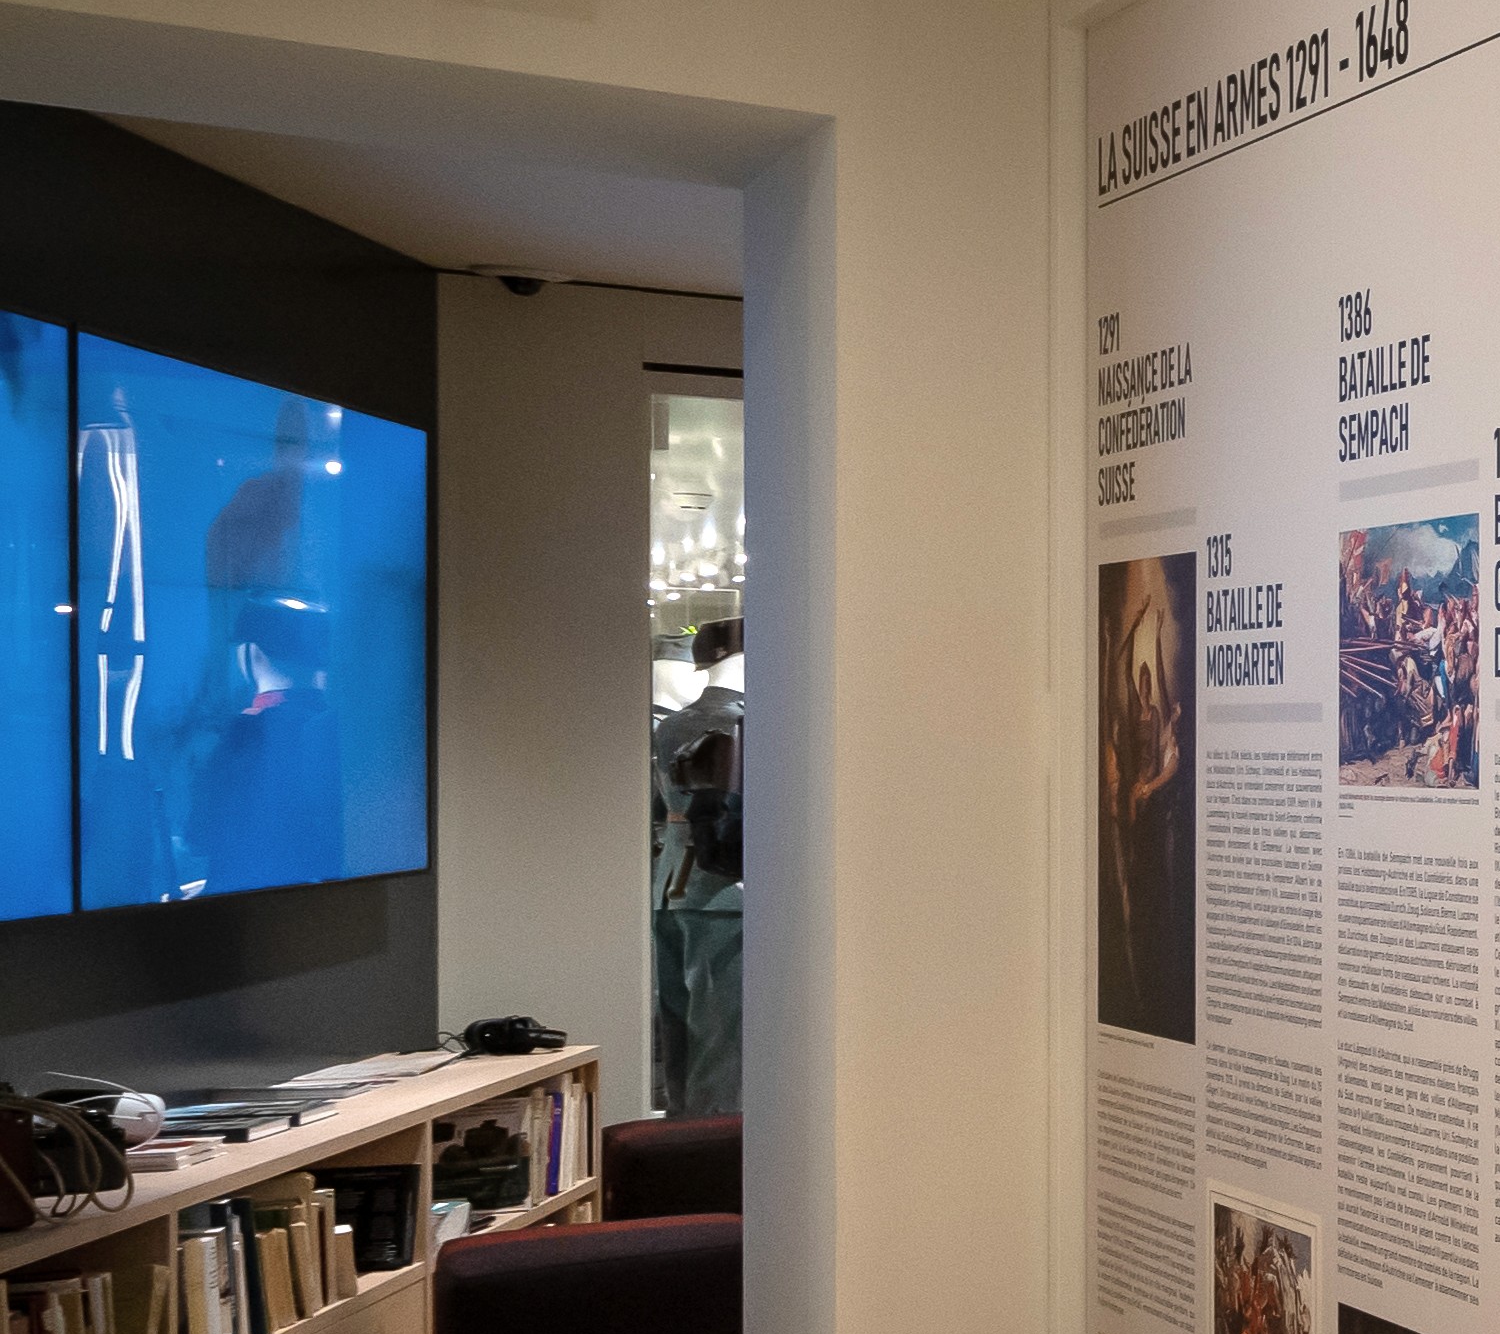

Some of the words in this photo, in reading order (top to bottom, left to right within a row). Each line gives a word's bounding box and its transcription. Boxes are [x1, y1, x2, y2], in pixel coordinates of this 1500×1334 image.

[1097, 130, 1118, 197] LA
[1121, 100, 1182, 183] SUISSE
[1185, 86, 1209, 159] EN
[1212, 52, 1281, 147] ARMES
[1285, 27, 1329, 114] 1291
[1339, 57, 1350, 72] -
[1097, 311, 1120, 356] 1291
[1338, 288, 1372, 343] 1386
[1098, 351, 1159, 407] NAISSANCE
[1160, 347, 1175, 391] DE
[1177, 343, 1193, 386] LA
[1338, 340, 1407, 403] BATAILLE
[1410, 333, 1431, 387] DE
[1098, 396, 1186, 457] CONFÉDÉRATION
[1338, 402, 1409, 463] SEMPACH
[1097, 460, 1136, 507] SUISSE
[1206, 533, 1232, 579] 1315
[1206, 585, 1264, 633] BATAILLE
[1266, 583, 1283, 629] DE
[1206, 642, 1284, 688] MORGARTEN
